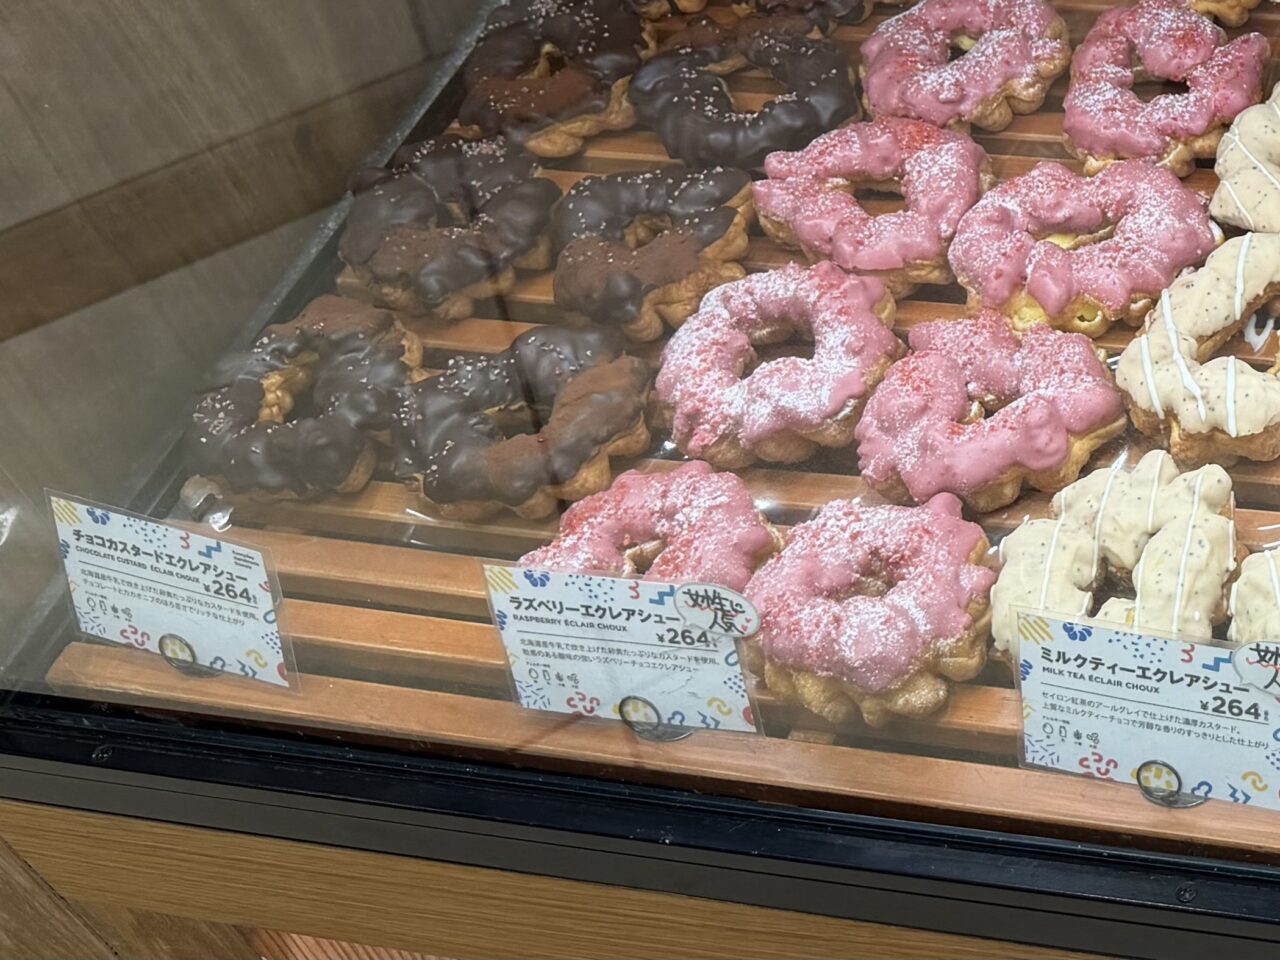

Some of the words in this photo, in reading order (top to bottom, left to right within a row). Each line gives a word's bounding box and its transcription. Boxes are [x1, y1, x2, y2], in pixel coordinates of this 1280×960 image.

[72, 528, 248, 583] チョコカスタードエクレアシュー
[75, 545, 116, 562] CHOCOLATE
[116, 555, 147, 570] CUSTARD
[203, 580, 252, 604] ¥264
[682, 589, 746, 613] 女性に
[509, 596, 681, 625] ラズベリーエクレアシュー
[513, 613, 562, 627] RASPBERRY
[597, 622, 628, 632] CHOUX
[708, 611, 744, 635] 人気
[656, 627, 709, 647] ¥264
[1040, 646, 1251, 694] ミルクティーエクレアシュー
[1042, 666, 1065, 677] MILK
[1066, 670, 1087, 682] TEA
[1087, 673, 1124, 688] ÉCLAIR
[1125, 681, 1161, 695] CHOUX
[1200, 696, 1261, 720] ¥264
